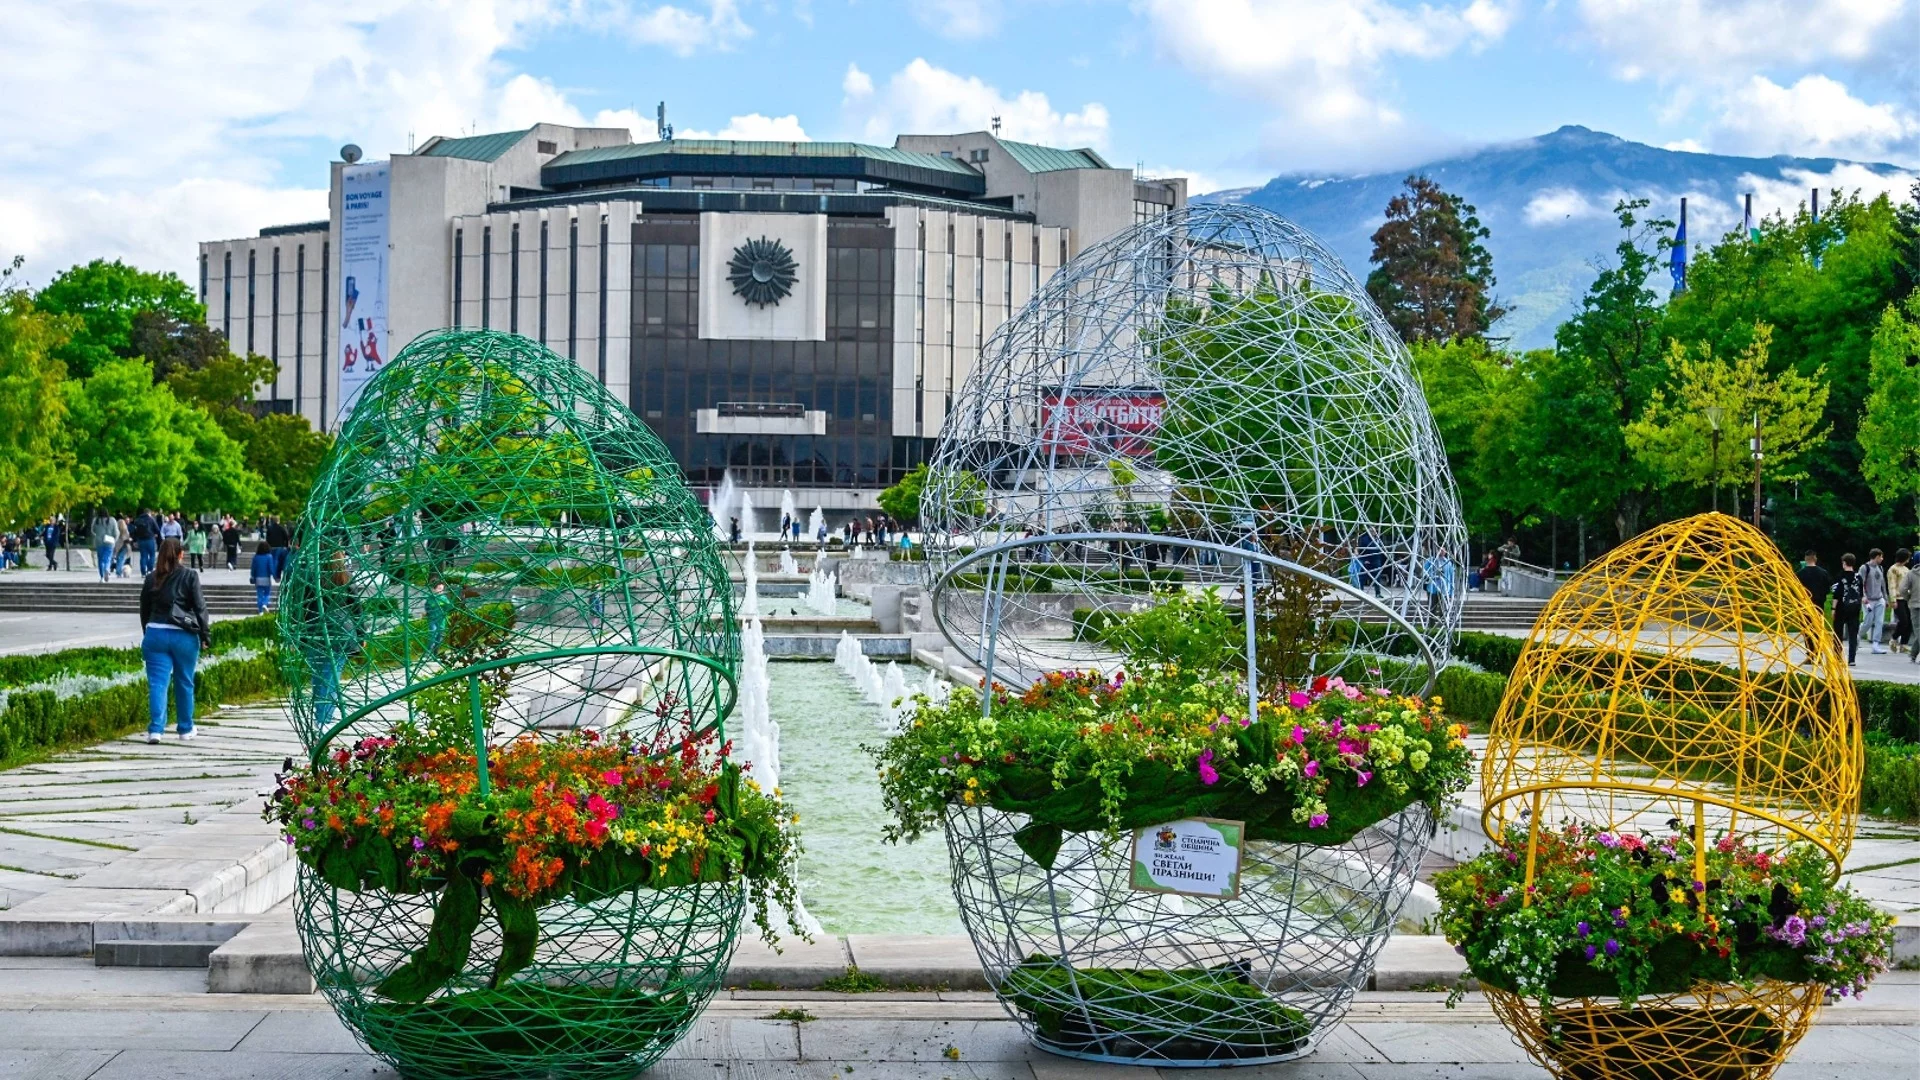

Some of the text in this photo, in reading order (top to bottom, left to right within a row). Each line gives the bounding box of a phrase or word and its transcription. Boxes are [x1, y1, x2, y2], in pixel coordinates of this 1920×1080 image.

[346, 190, 382, 201] BON VOYAGE
[1181, 837, 1220, 847] СТОЛИЧНА
[1181, 843, 1213, 852] ОБЩИНА
[1153, 859, 1192, 870] СВЕТЛИ
[1152, 868, 1216, 882] ПРАЗНИЦИ!
